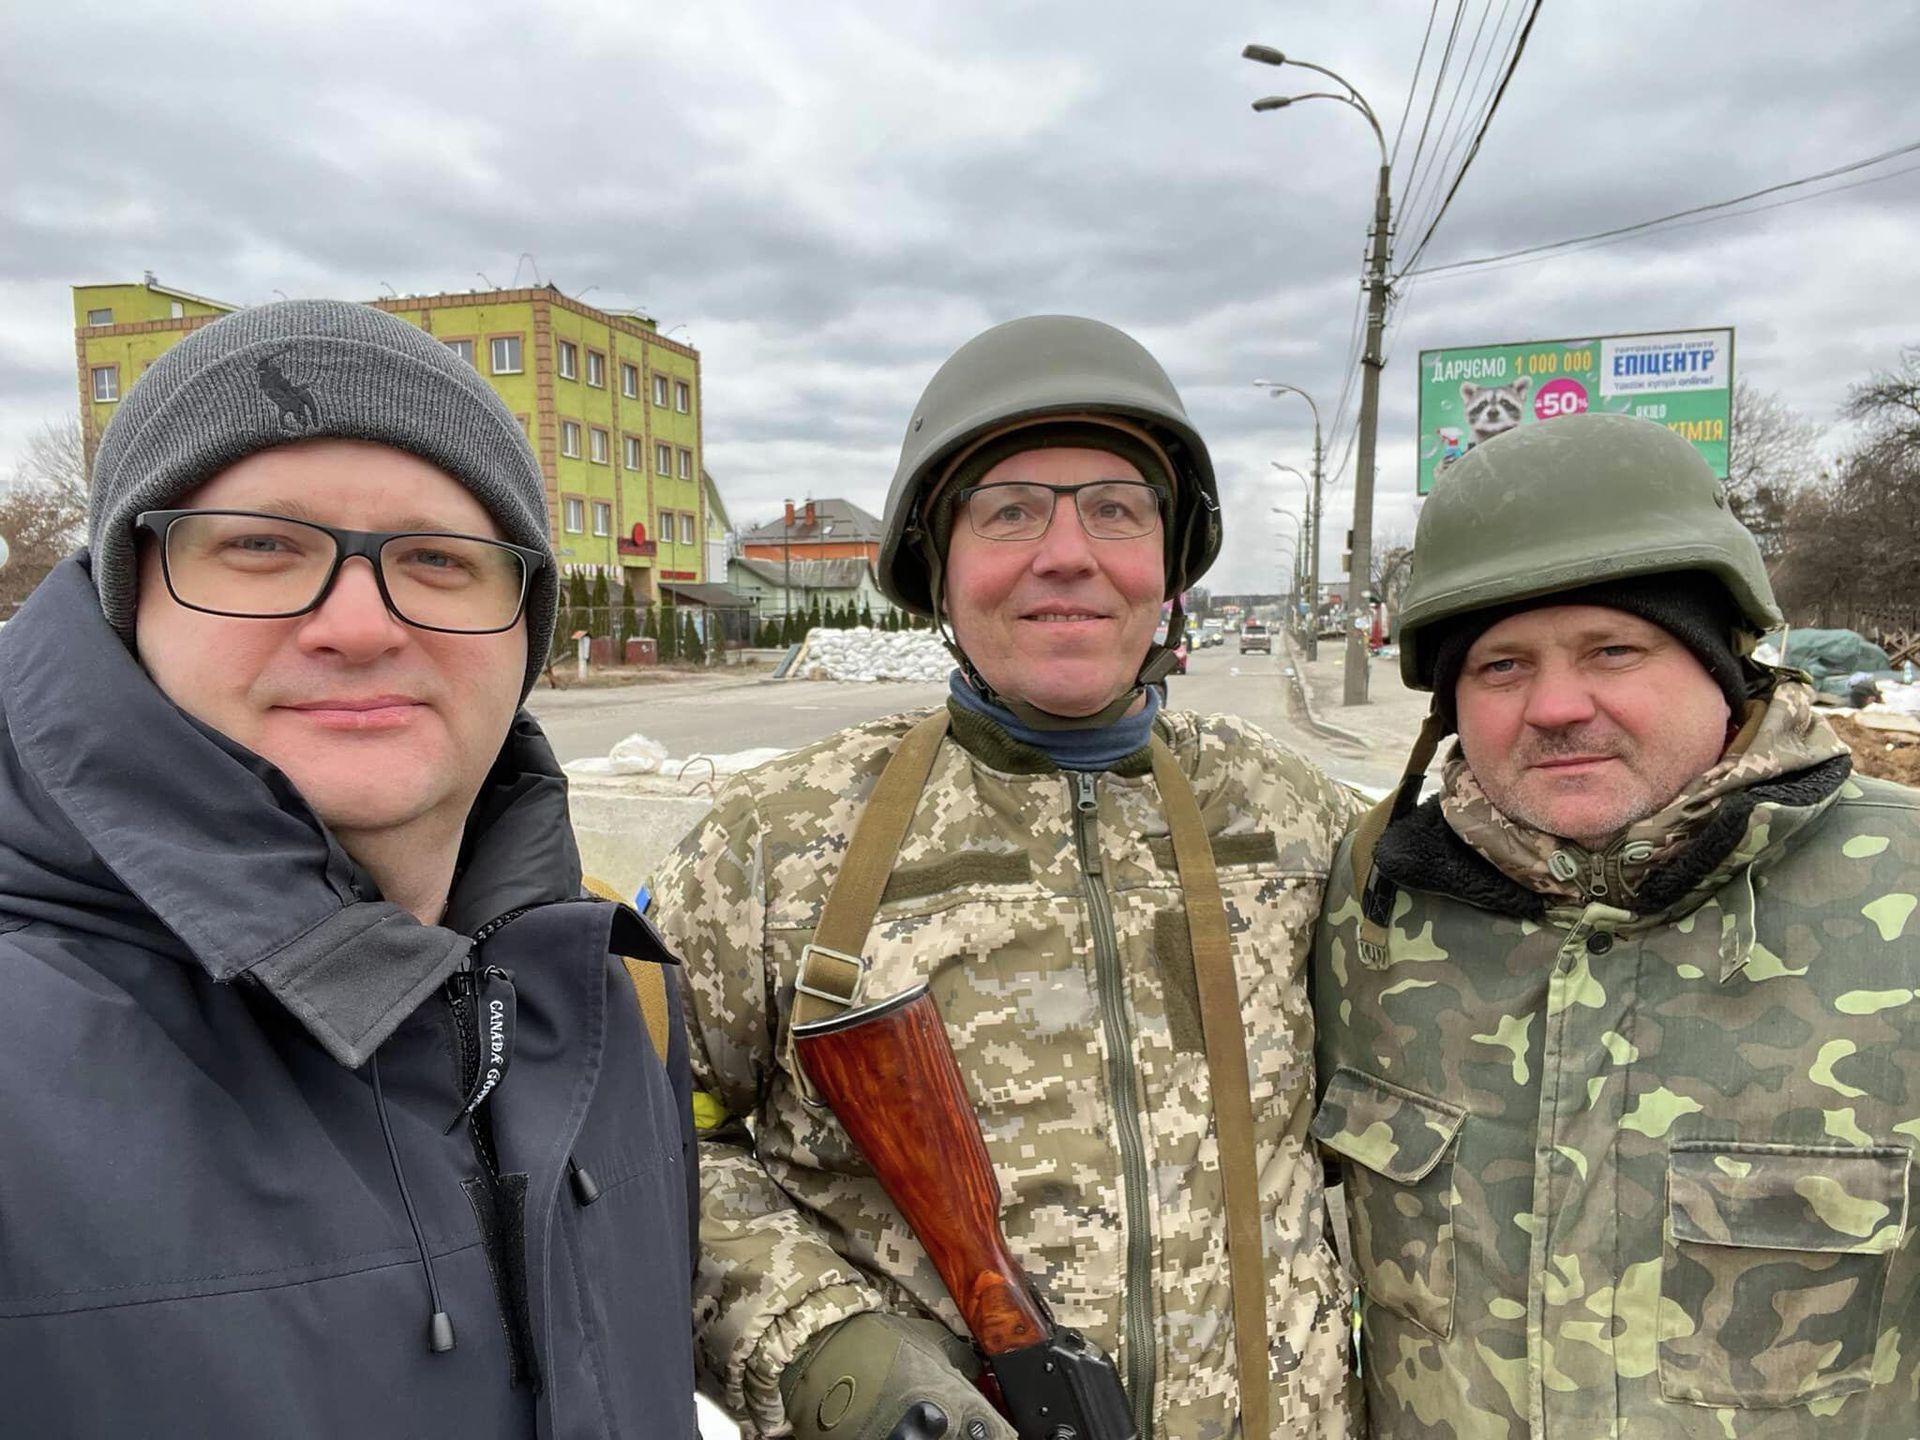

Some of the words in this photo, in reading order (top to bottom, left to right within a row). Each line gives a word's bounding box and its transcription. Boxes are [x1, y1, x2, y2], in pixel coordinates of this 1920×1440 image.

[1431, 356, 1506, 383] ДАРУЄМО
[1514, 355, 1523, 374] 1
[1529, 353, 1557, 374] 000
[1563, 350, 1592, 372] 000
[1613, 349, 1714, 376] ЕПІЦЕНТР
[489, 999, 504, 1066] CANADA
